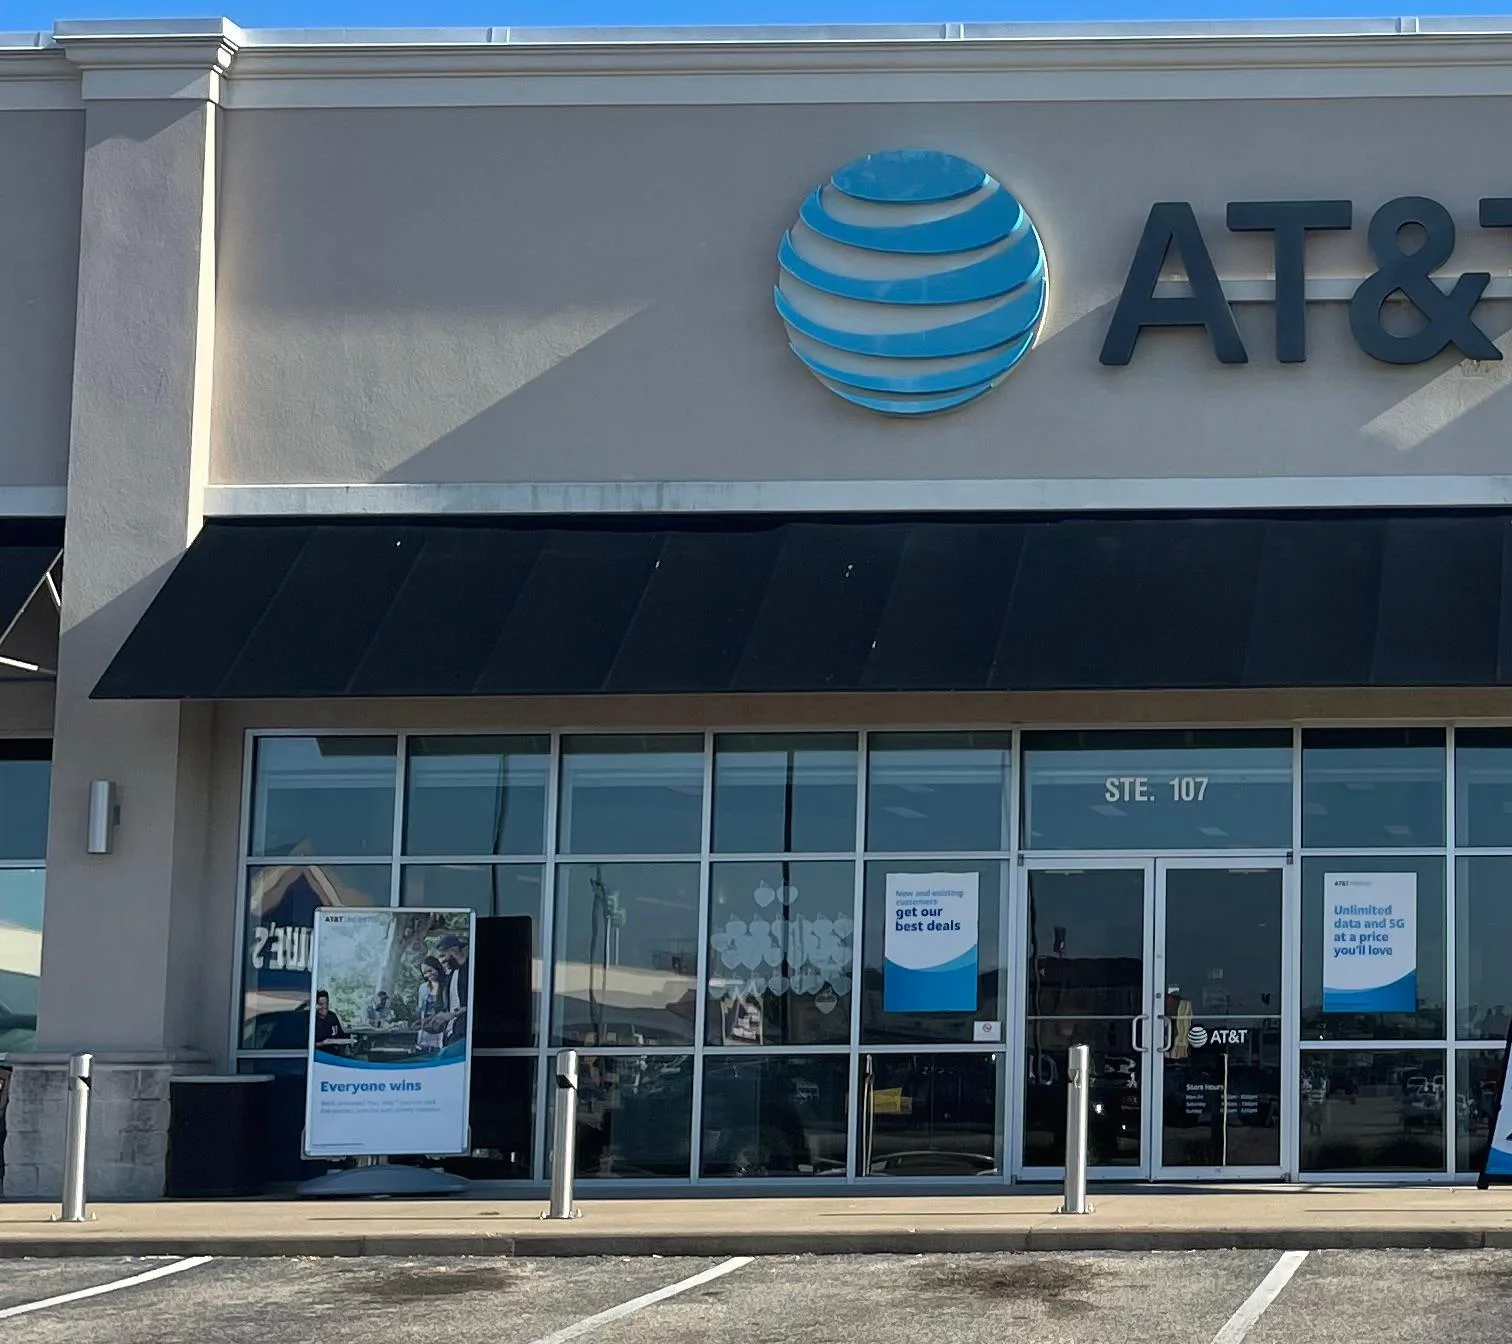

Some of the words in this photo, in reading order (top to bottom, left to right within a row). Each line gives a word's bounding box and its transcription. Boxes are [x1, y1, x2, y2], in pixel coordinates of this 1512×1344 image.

[1105, 777, 1155, 802] STE.
[1169, 777, 1209, 802] 107
[896, 907, 918, 920] get
[920, 907, 943, 917] our
[1334, 904, 1392, 915] Unlimited
[895, 920, 924, 932] best
[926, 919, 961, 931] deals
[1334, 918, 1361, 929] data
[1364, 917, 1387, 929] and
[1389, 918, 1405, 929] 5G
[1333, 932, 1346, 942] at
[1349, 934, 1357, 942] a
[1360, 931, 1389, 944] price
[1369, 944, 1393, 956] love
[1210, 1029, 1248, 1044] AT&T
[320, 1081, 386, 1095] Everyone
[390, 1079, 422, 1092] wins
